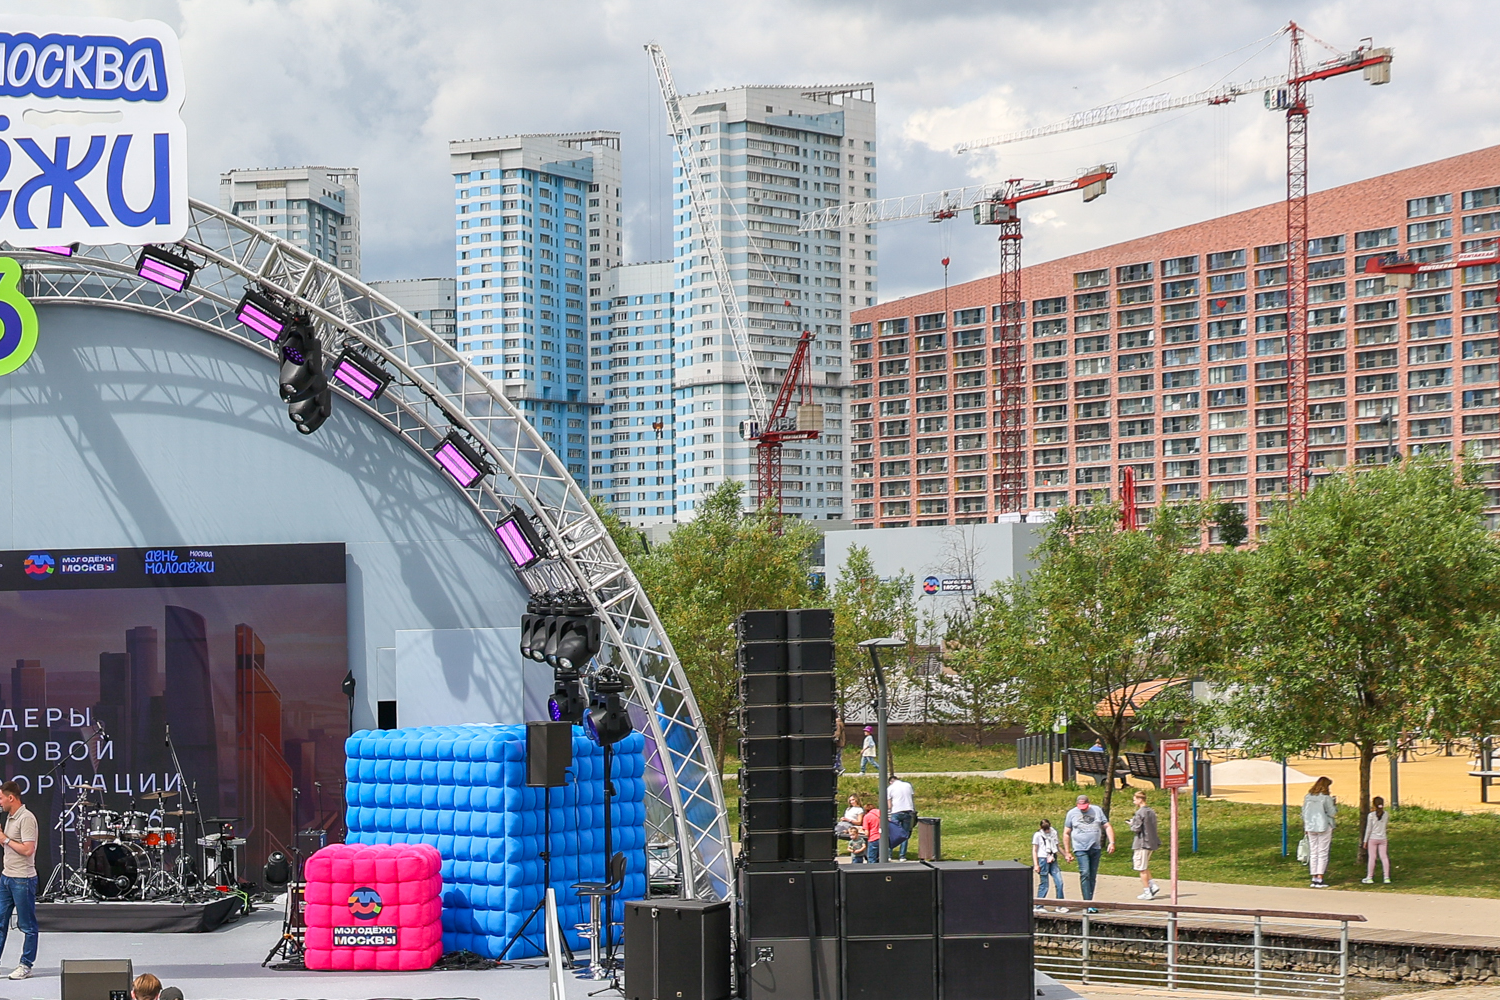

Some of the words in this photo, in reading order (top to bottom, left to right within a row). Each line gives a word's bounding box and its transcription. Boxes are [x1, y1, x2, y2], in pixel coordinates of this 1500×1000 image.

[62, 563, 115, 573] МОСКВЫ
[334, 926, 396, 935] МОЛОДЁЖЬ
[334, 936, 397, 945] МОСКВЫ
